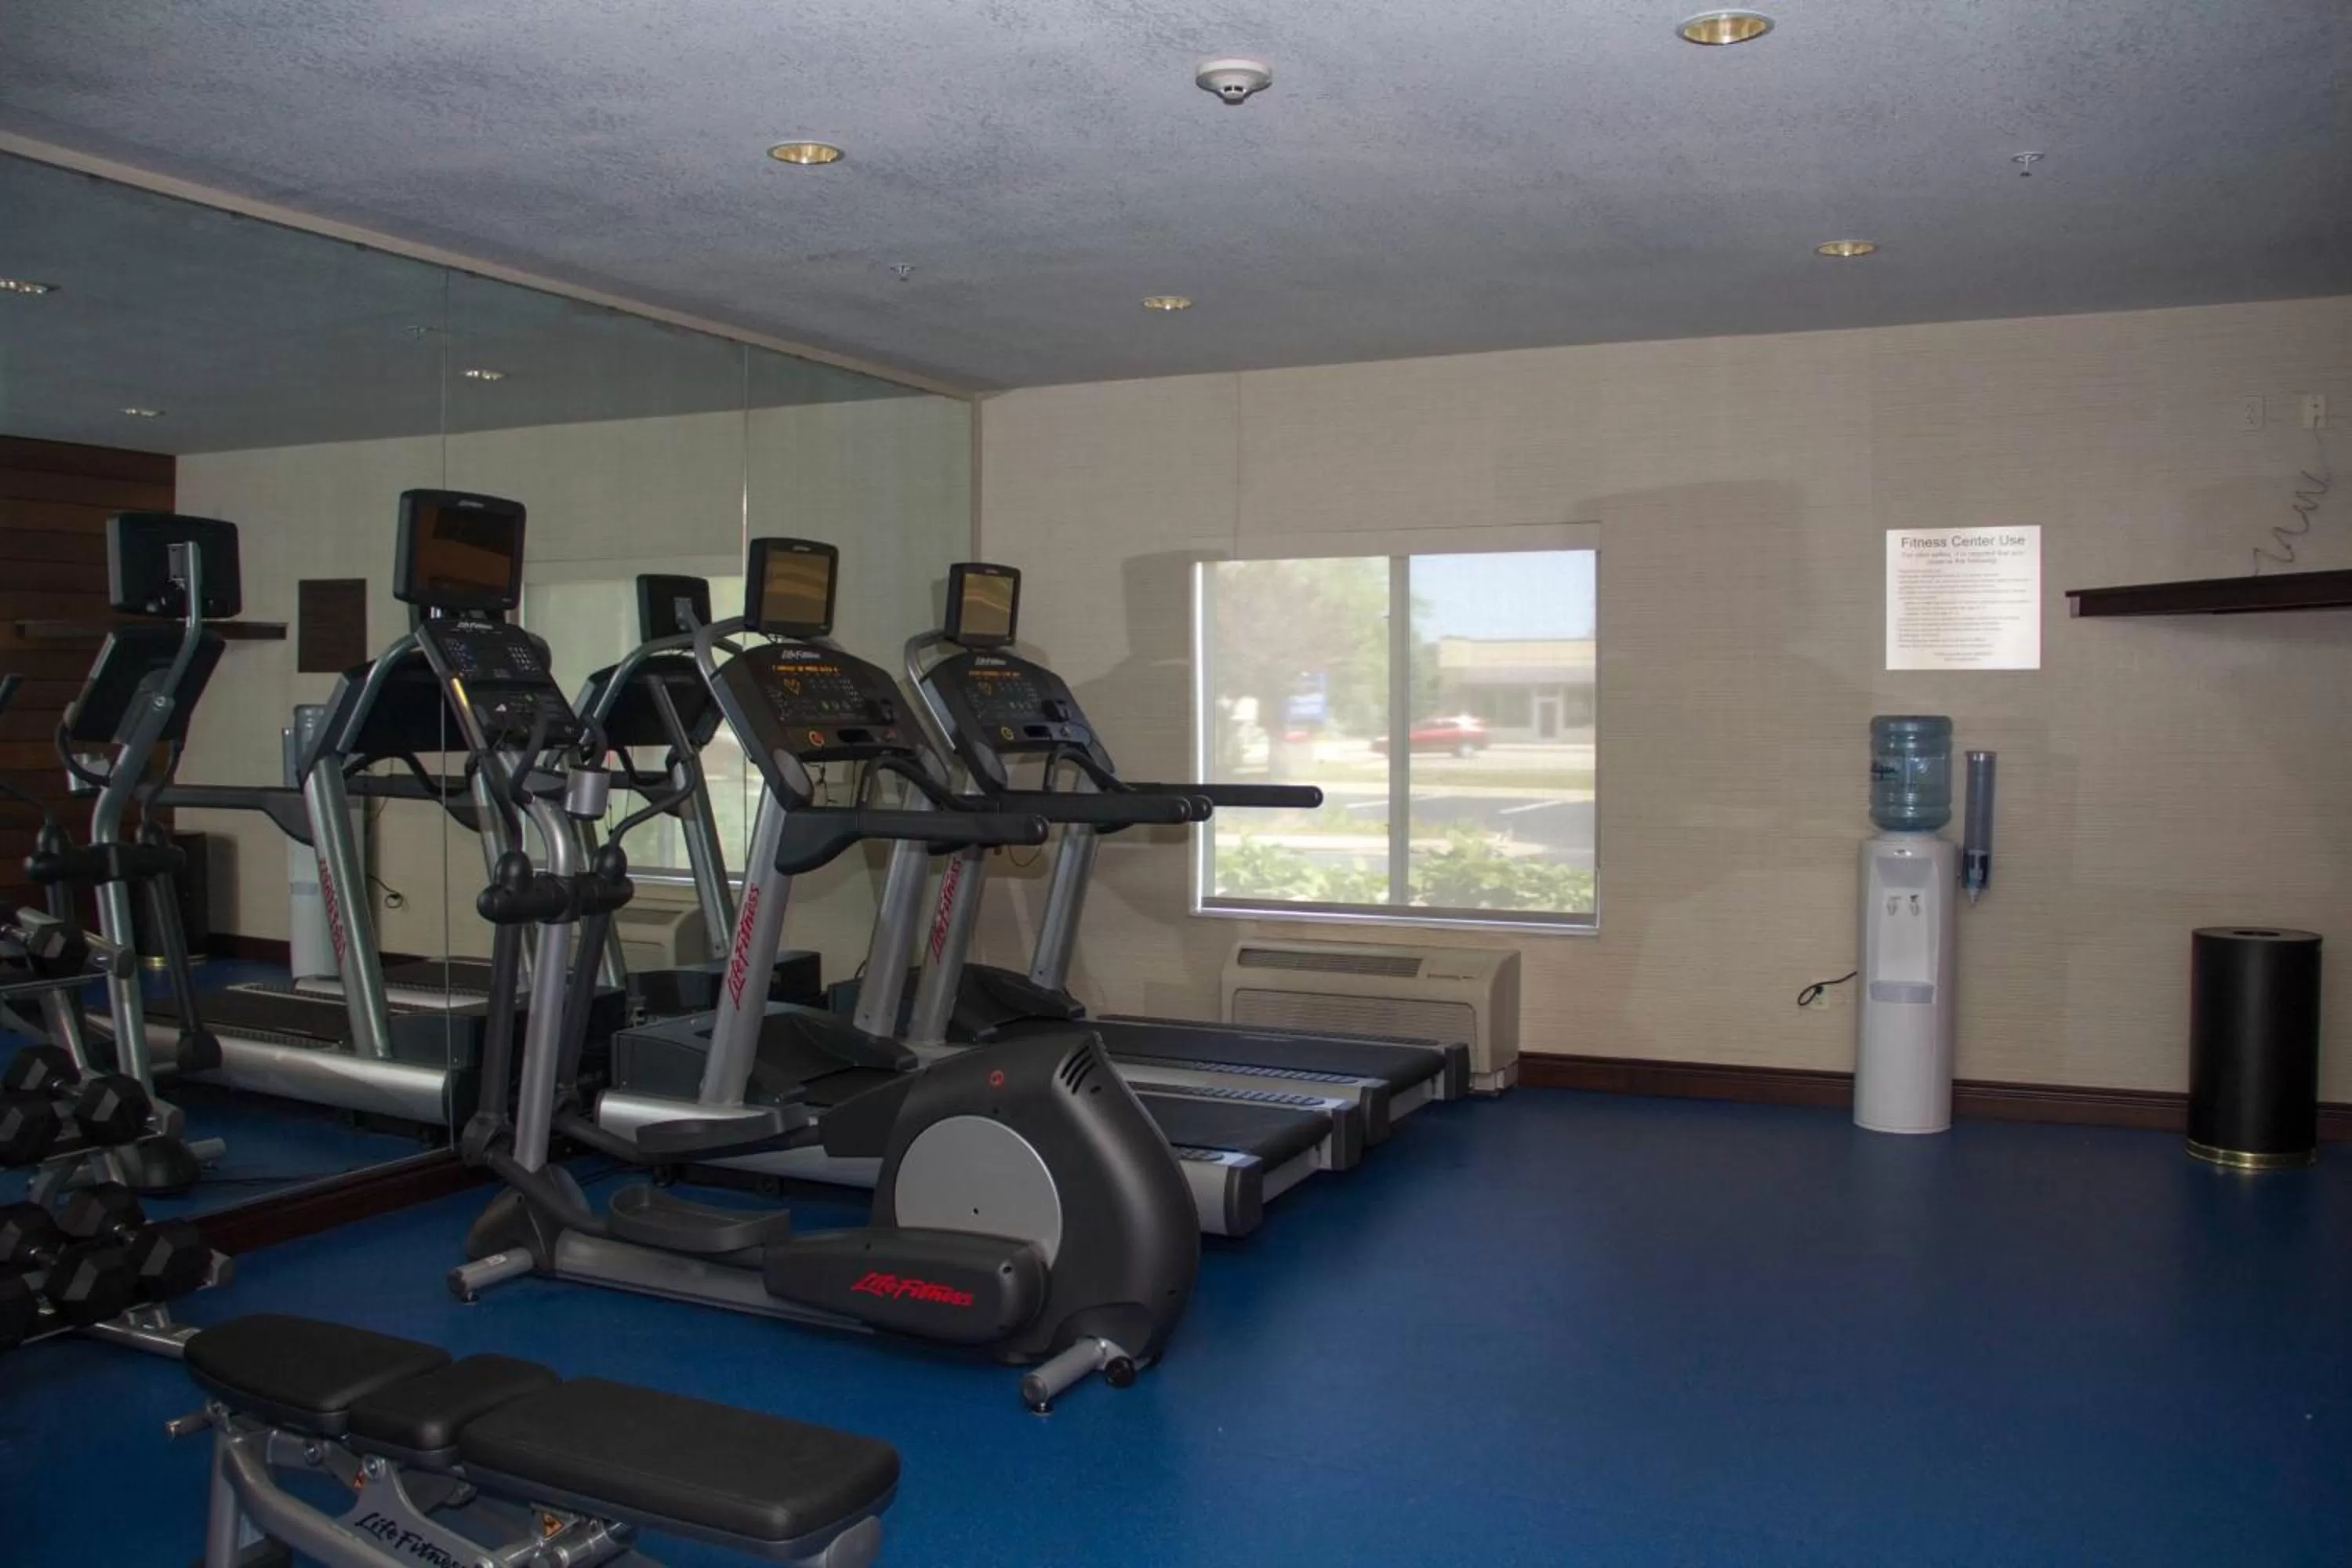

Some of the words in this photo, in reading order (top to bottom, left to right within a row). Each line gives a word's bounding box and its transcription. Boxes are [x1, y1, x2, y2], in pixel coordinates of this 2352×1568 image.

[1900, 537, 1947, 548] Fitness
[1951, 535, 1995, 547] Center
[1999, 534, 2026, 546] Use
[735, 883, 759, 967] Fitness
[851, 1272, 898, 1297] Life
[893, 1279, 972, 1305] Fitness
[354, 1512, 397, 1541] Life
